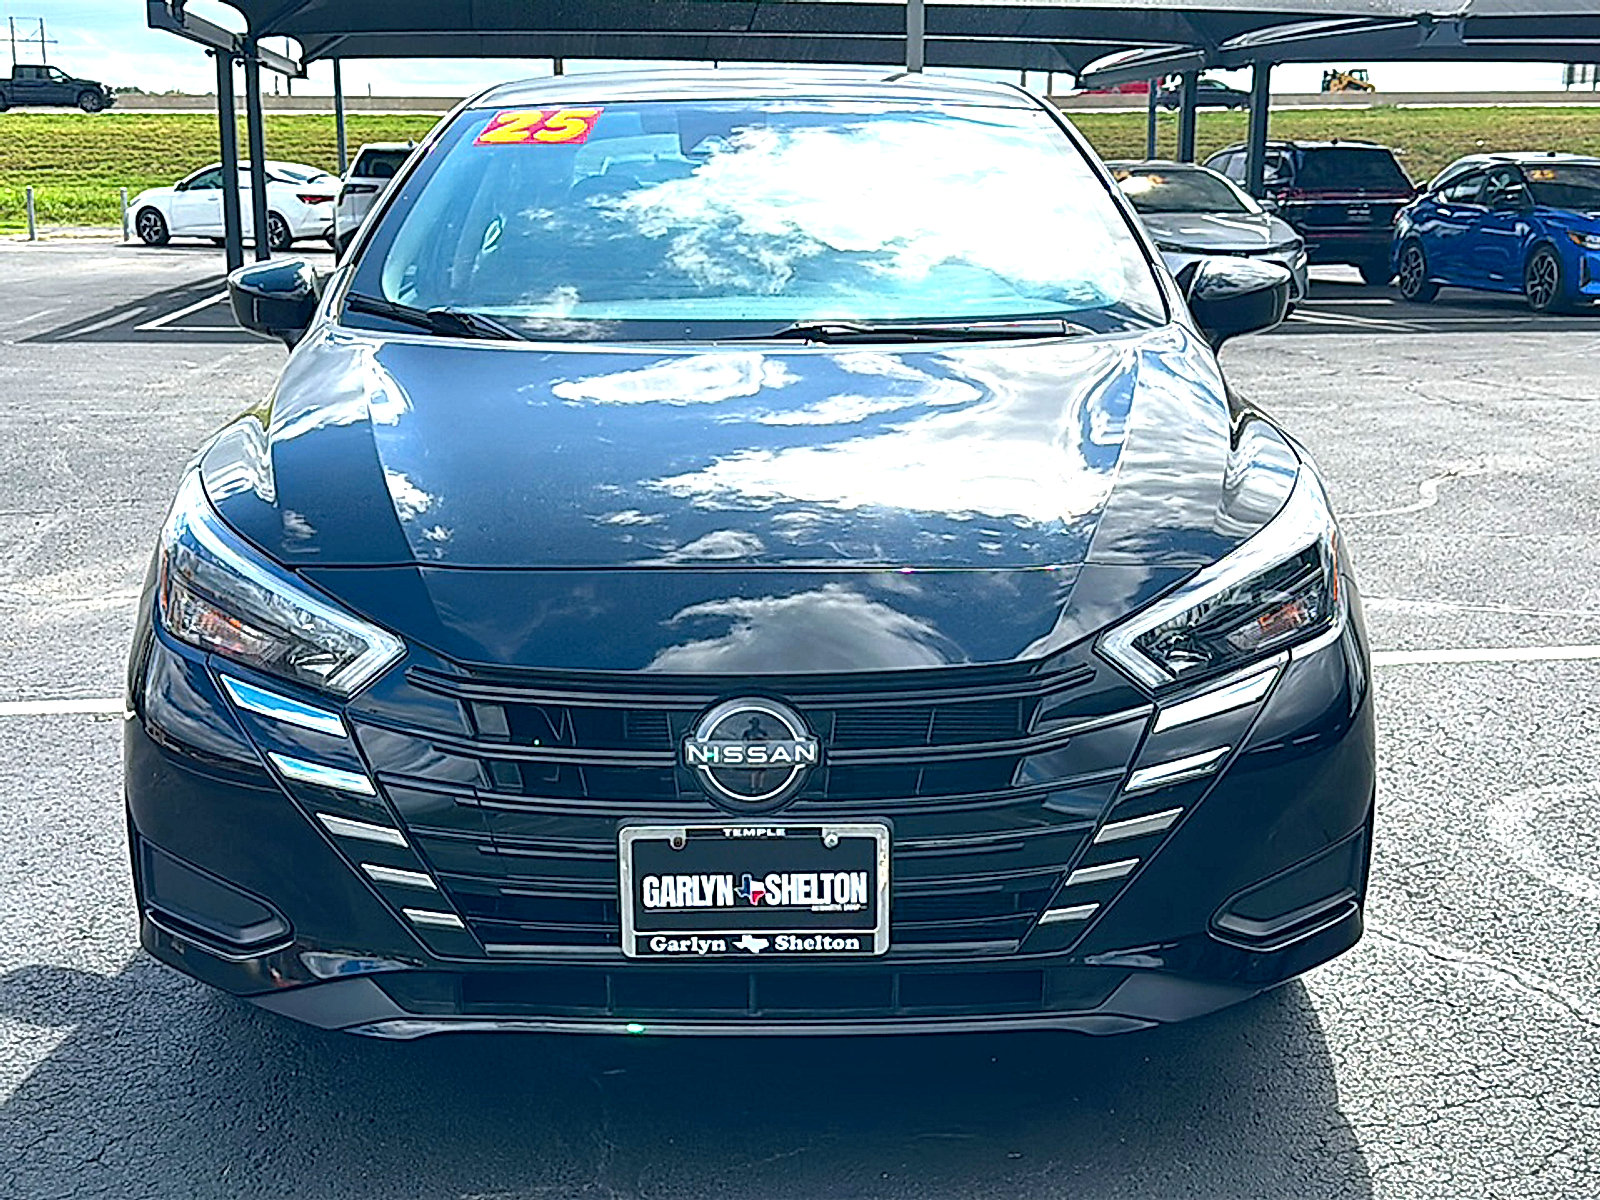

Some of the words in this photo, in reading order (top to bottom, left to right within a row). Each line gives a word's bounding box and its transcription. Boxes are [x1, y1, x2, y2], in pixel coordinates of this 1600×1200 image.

[480, 110, 598, 141] 25
[688, 744, 815, 763] NISSAN
[723, 828, 786, 836] TEMPLE
[643, 874, 734, 907] GARLYN
[764, 872, 867, 905] SHELTON
[650, 937, 726, 955] Garlyn
[774, 935, 860, 951] Shelton
